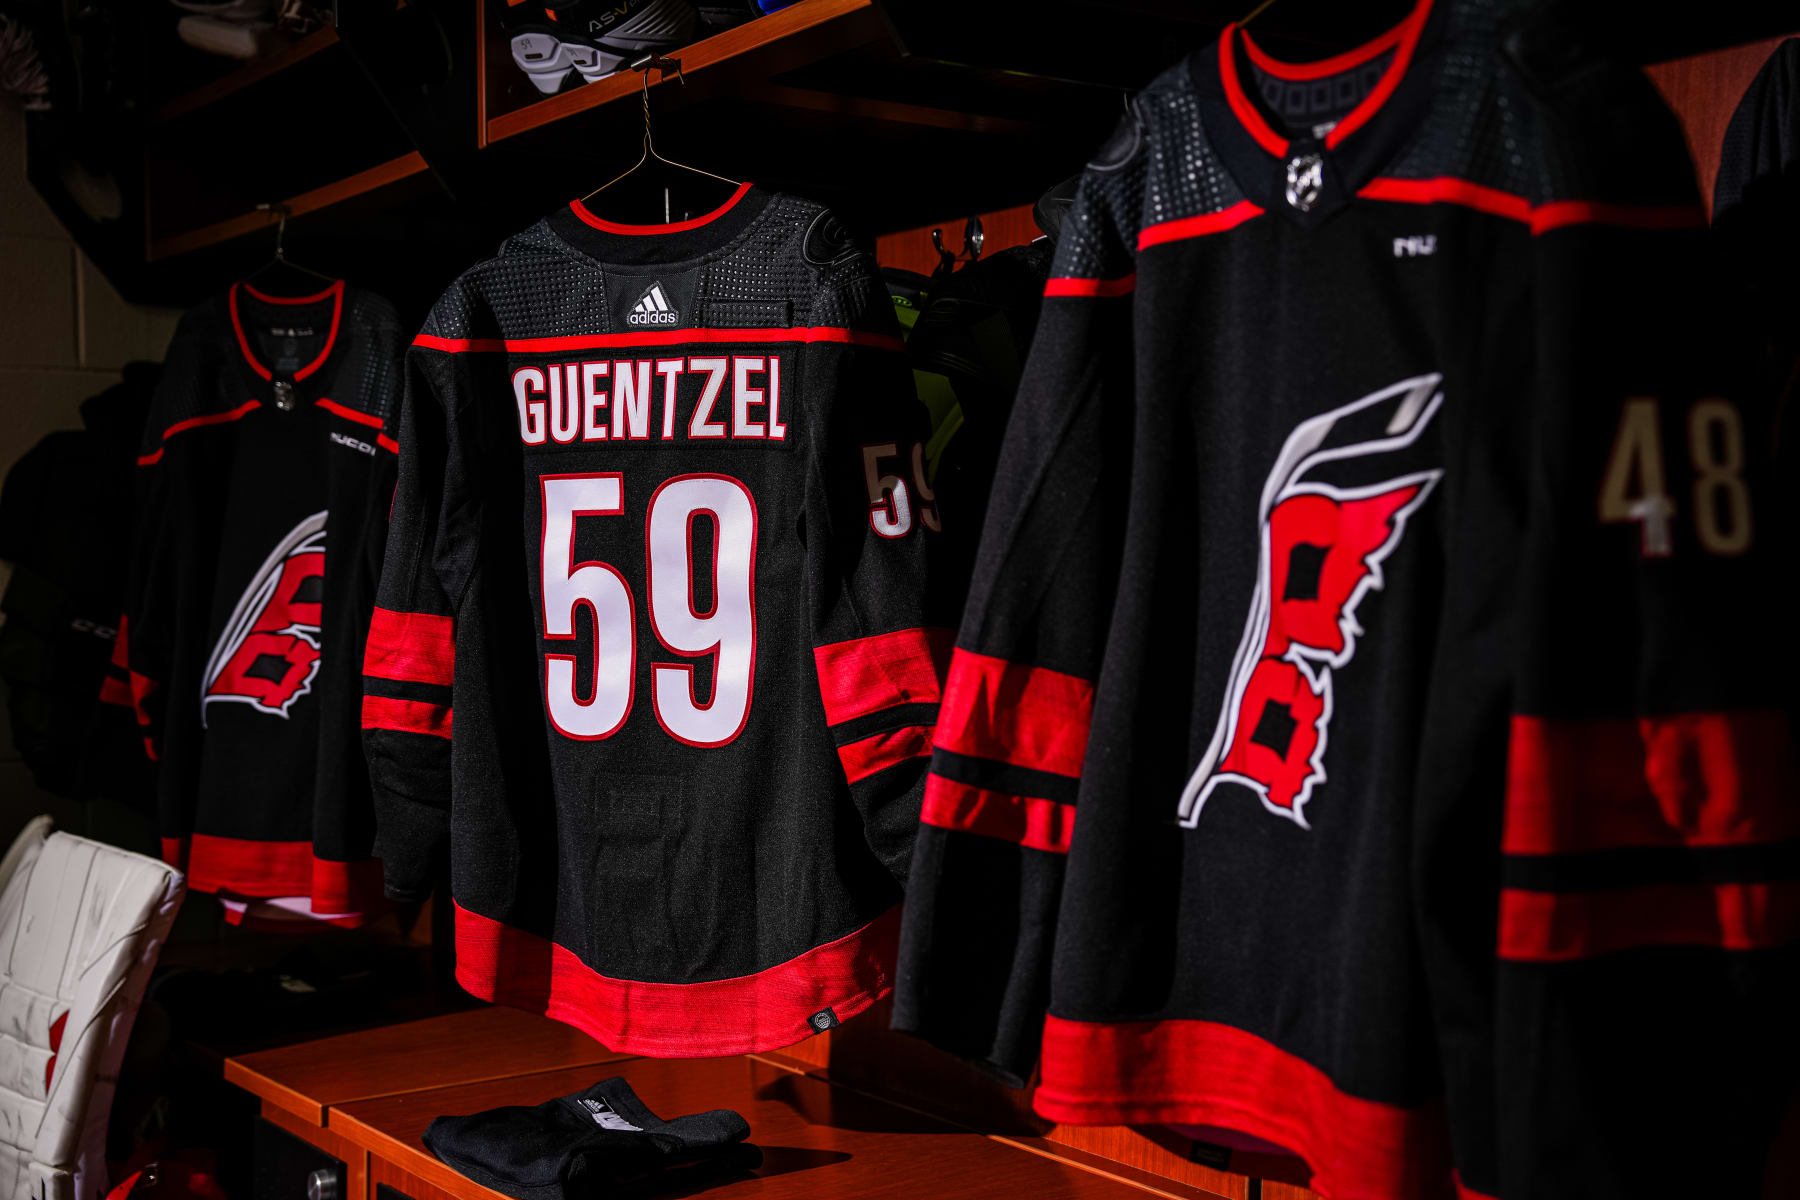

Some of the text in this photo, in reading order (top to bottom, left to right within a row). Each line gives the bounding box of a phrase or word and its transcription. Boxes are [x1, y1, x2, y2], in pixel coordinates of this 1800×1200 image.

[629, 310, 676, 325] adidas
[511, 356, 787, 446] GUENTZEL
[1599, 397, 1752, 556] 48
[539, 472, 759, 749] 59
